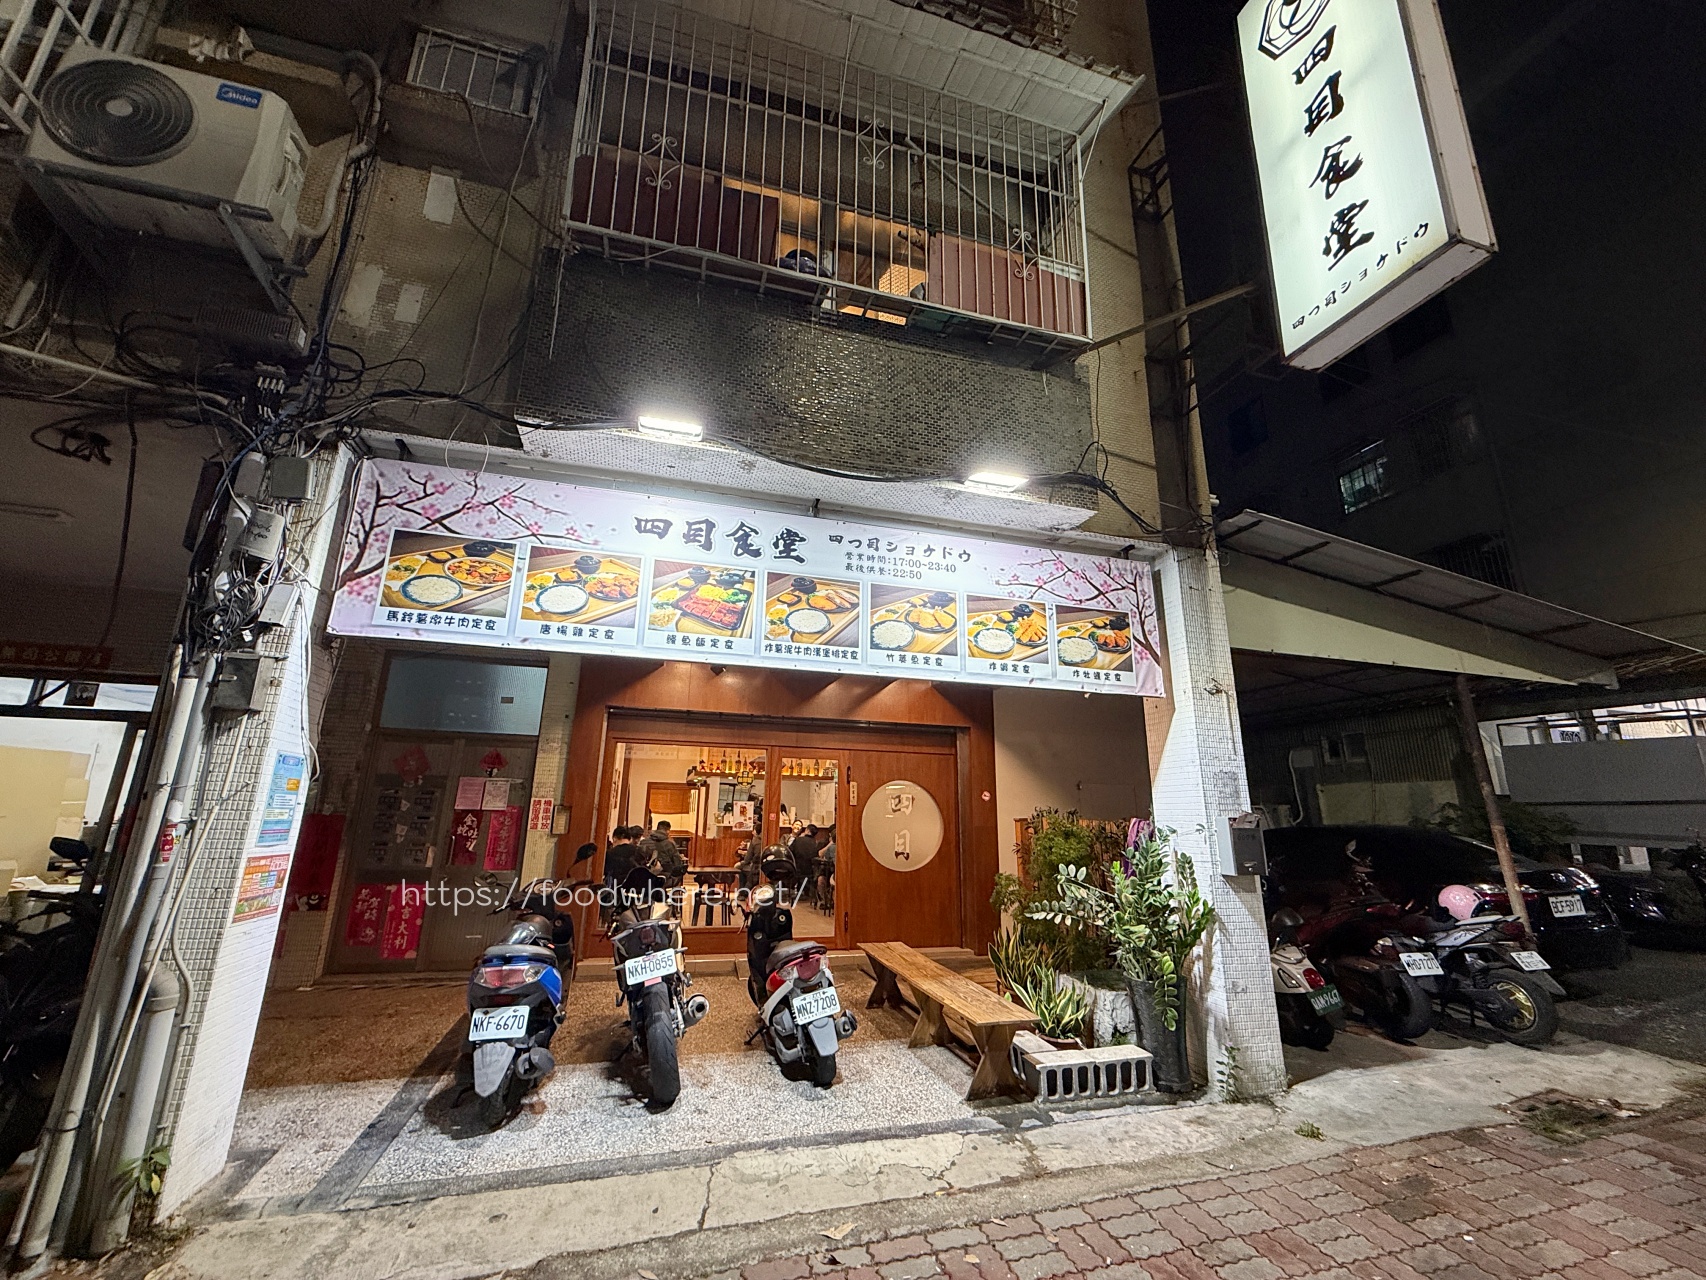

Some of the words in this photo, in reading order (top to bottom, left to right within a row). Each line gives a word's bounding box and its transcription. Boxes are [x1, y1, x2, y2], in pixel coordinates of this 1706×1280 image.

[222, 88, 258, 104] Midea
[634, 517, 807, 564] 四目食堂
[386, 610, 497, 631] 馬鈴薯燉牛肉定食
[540, 623, 615, 640] 唐揚雞定食
[666, 634, 734, 650] 鰻魚飯定食
[627, 954, 674, 979] NKH-0855
[795, 994, 838, 1019] MNZ-7208
[471, 1014, 526, 1034] NKF-6670
